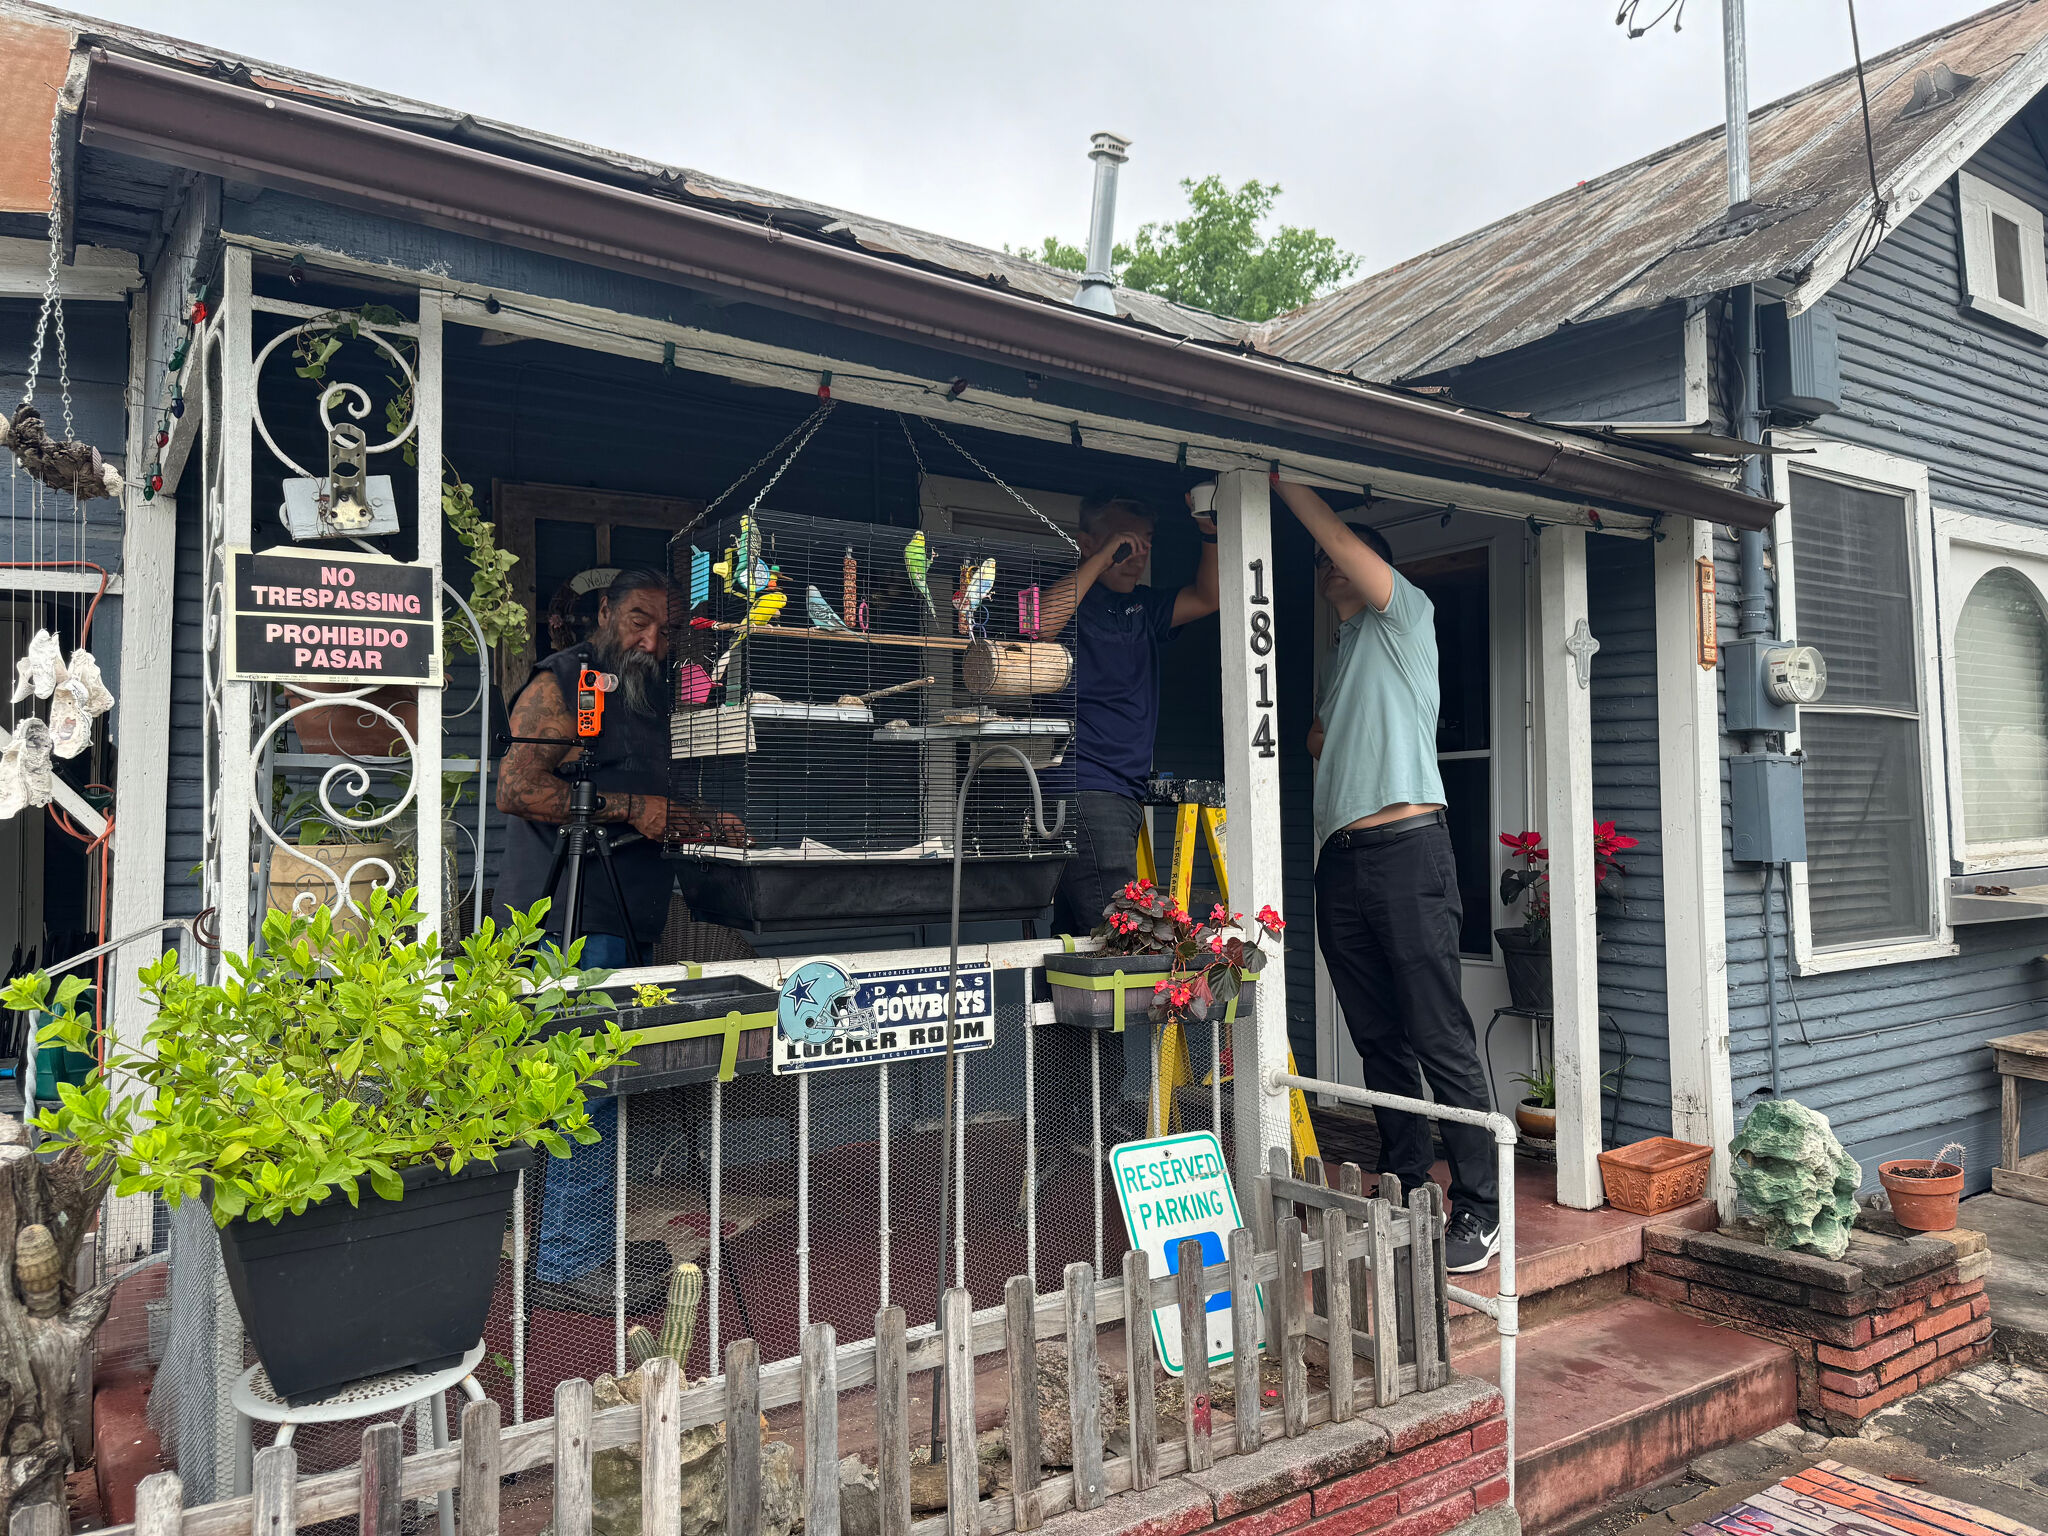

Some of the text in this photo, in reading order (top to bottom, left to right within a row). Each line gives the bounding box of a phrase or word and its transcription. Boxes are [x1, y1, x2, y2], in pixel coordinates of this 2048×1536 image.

[321, 566, 355, 587] NO
[251, 585, 421, 614] TRESPASSING
[266, 623, 408, 648] PROHIBIDO
[295, 648, 382, 670] PASAR
[1248, 558, 1276, 758] 1814
[867, 968, 915, 978] AUTHORIZED
[874, 976, 984, 996] DALLAS
[787, 1031, 897, 1060] LOCKER
[846, 1047, 934, 1063] PASS REQUIRED
[1122, 1153, 1219, 1193] RESERVED
[1139, 1190, 1223, 1230] PARKING
